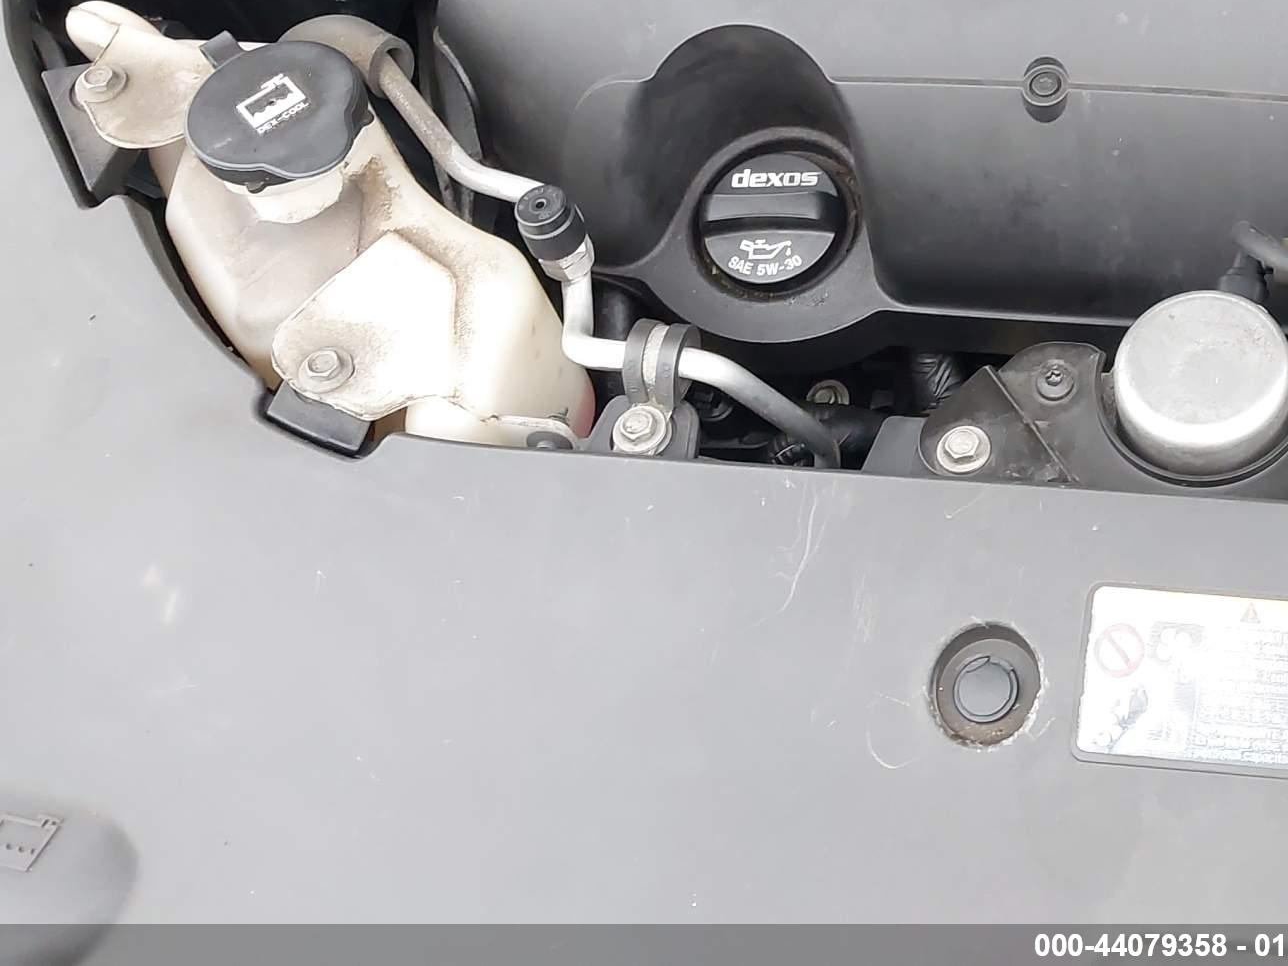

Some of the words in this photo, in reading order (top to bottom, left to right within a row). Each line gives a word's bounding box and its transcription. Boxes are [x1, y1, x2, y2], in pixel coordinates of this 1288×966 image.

[256, 101, 309, 135] DEX-COOL
[731, 168, 823, 188] dexos
[728, 256, 754, 275] SAE
[756, 255, 802, 276] 5W-30
